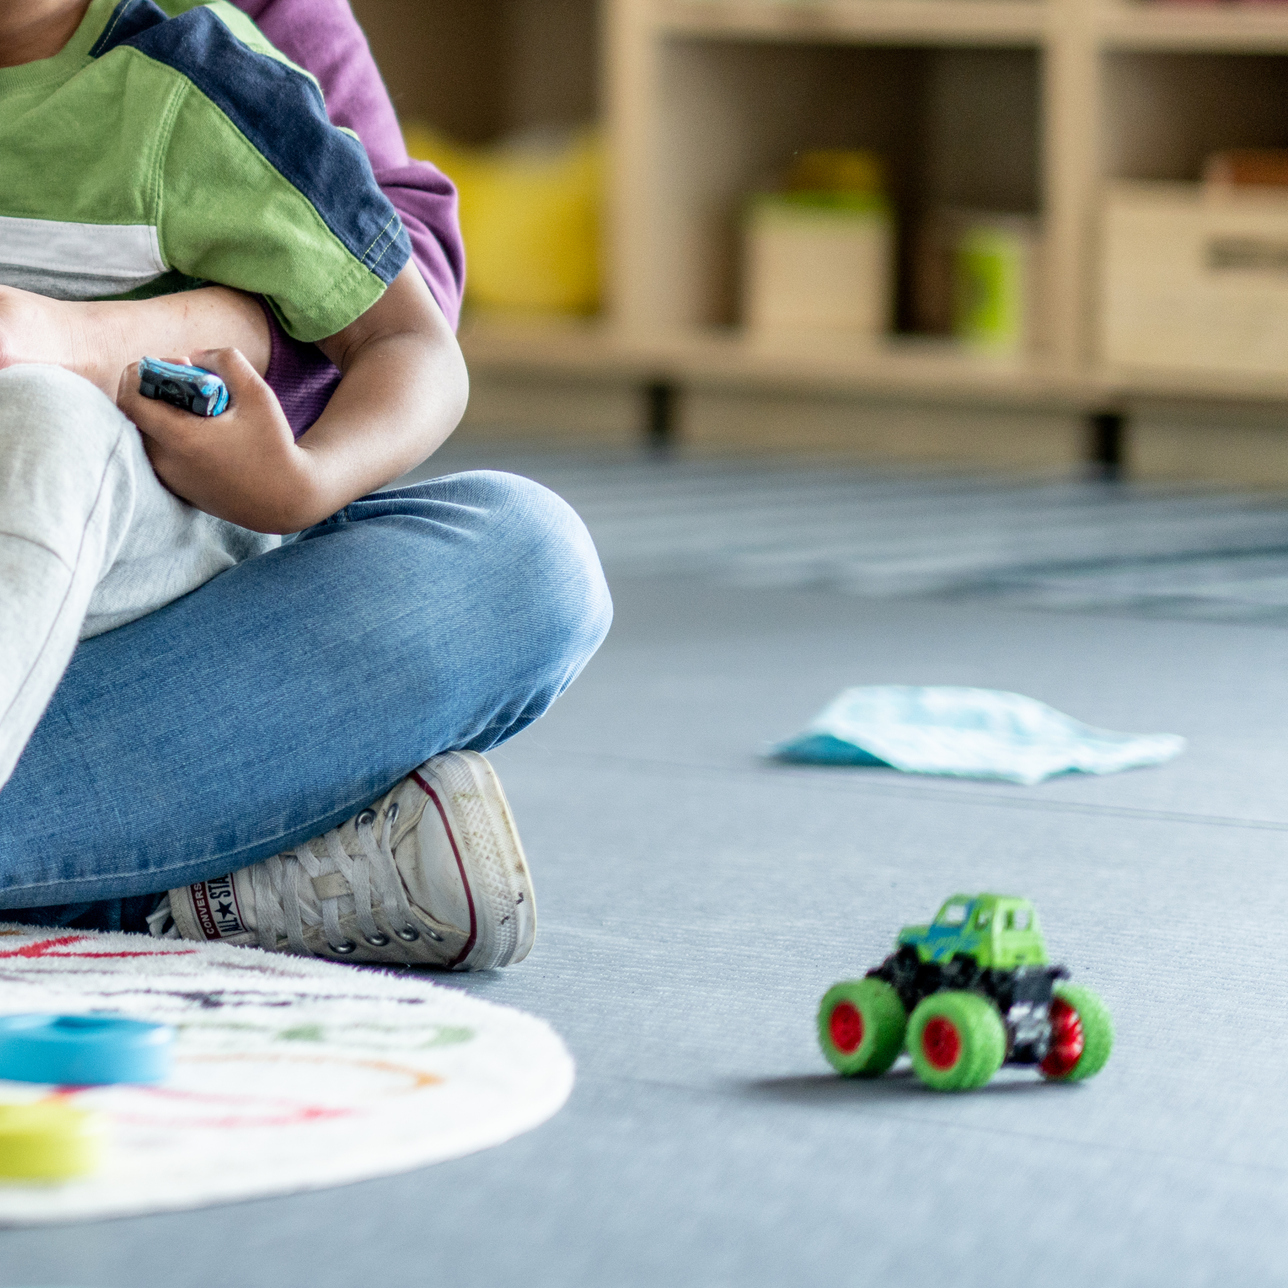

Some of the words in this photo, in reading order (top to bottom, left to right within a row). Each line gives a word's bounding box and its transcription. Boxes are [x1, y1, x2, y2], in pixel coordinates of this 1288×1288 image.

[207, 874, 231, 899] STA
[193, 883, 215, 935] CONVERS
[217, 917, 243, 932] ALL
